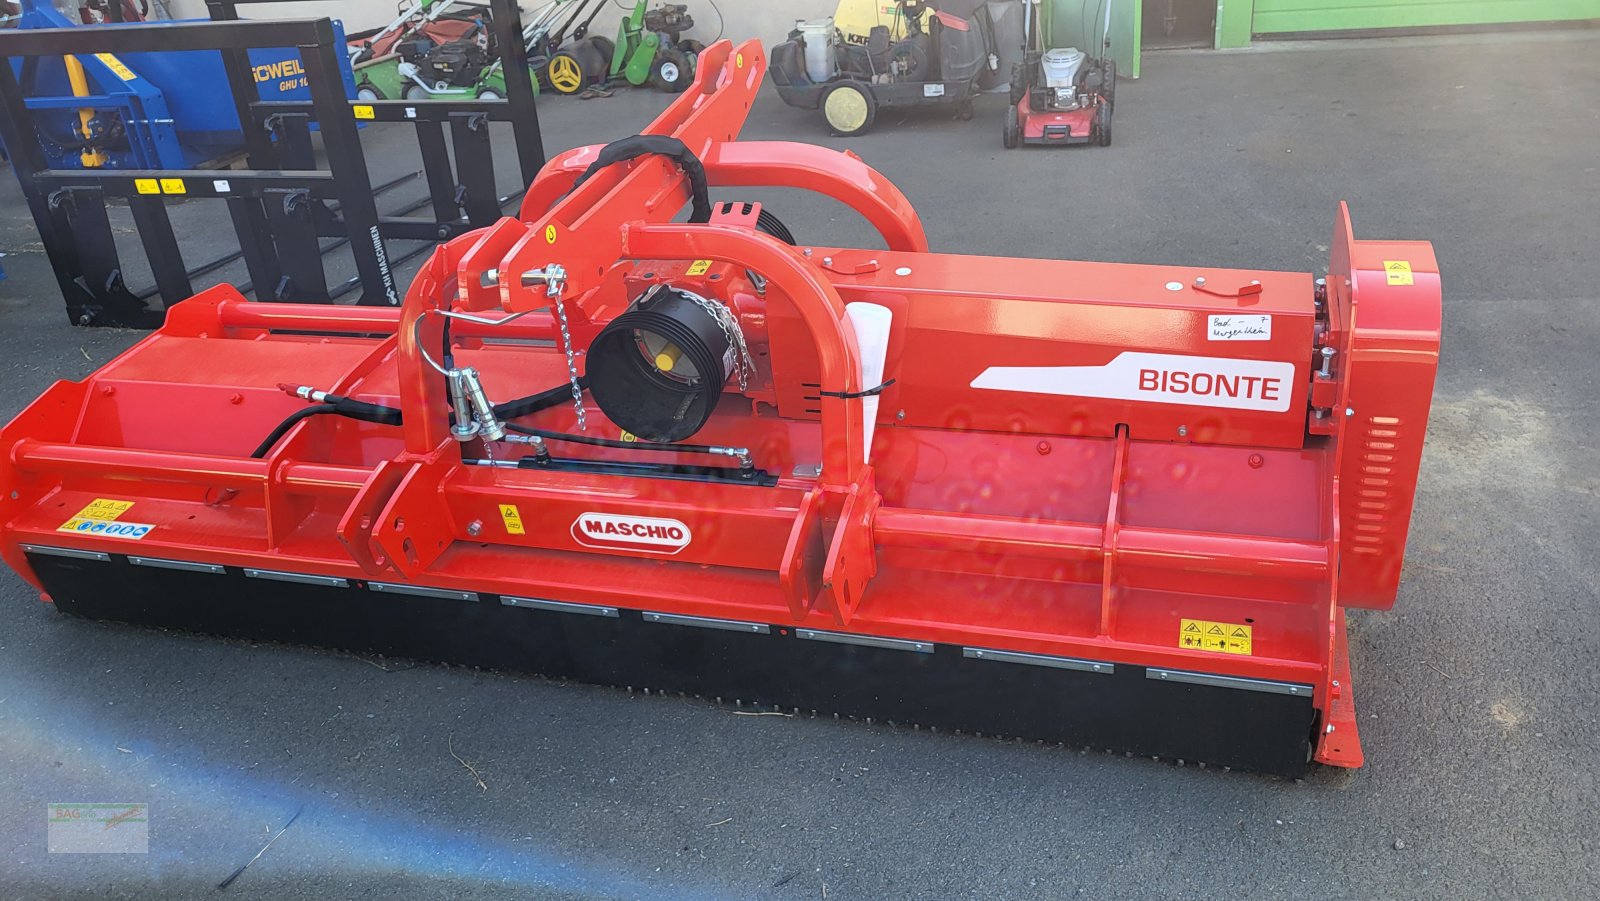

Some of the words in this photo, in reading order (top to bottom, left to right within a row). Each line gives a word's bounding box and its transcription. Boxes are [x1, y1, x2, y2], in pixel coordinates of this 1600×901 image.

[280, 78, 298, 92] GHU
[370, 225, 389, 275] MASCHINEN
[382, 273, 392, 288] KH
[1139, 368, 1281, 401] BISONTE
[584, 520, 684, 540] MASCHIO
